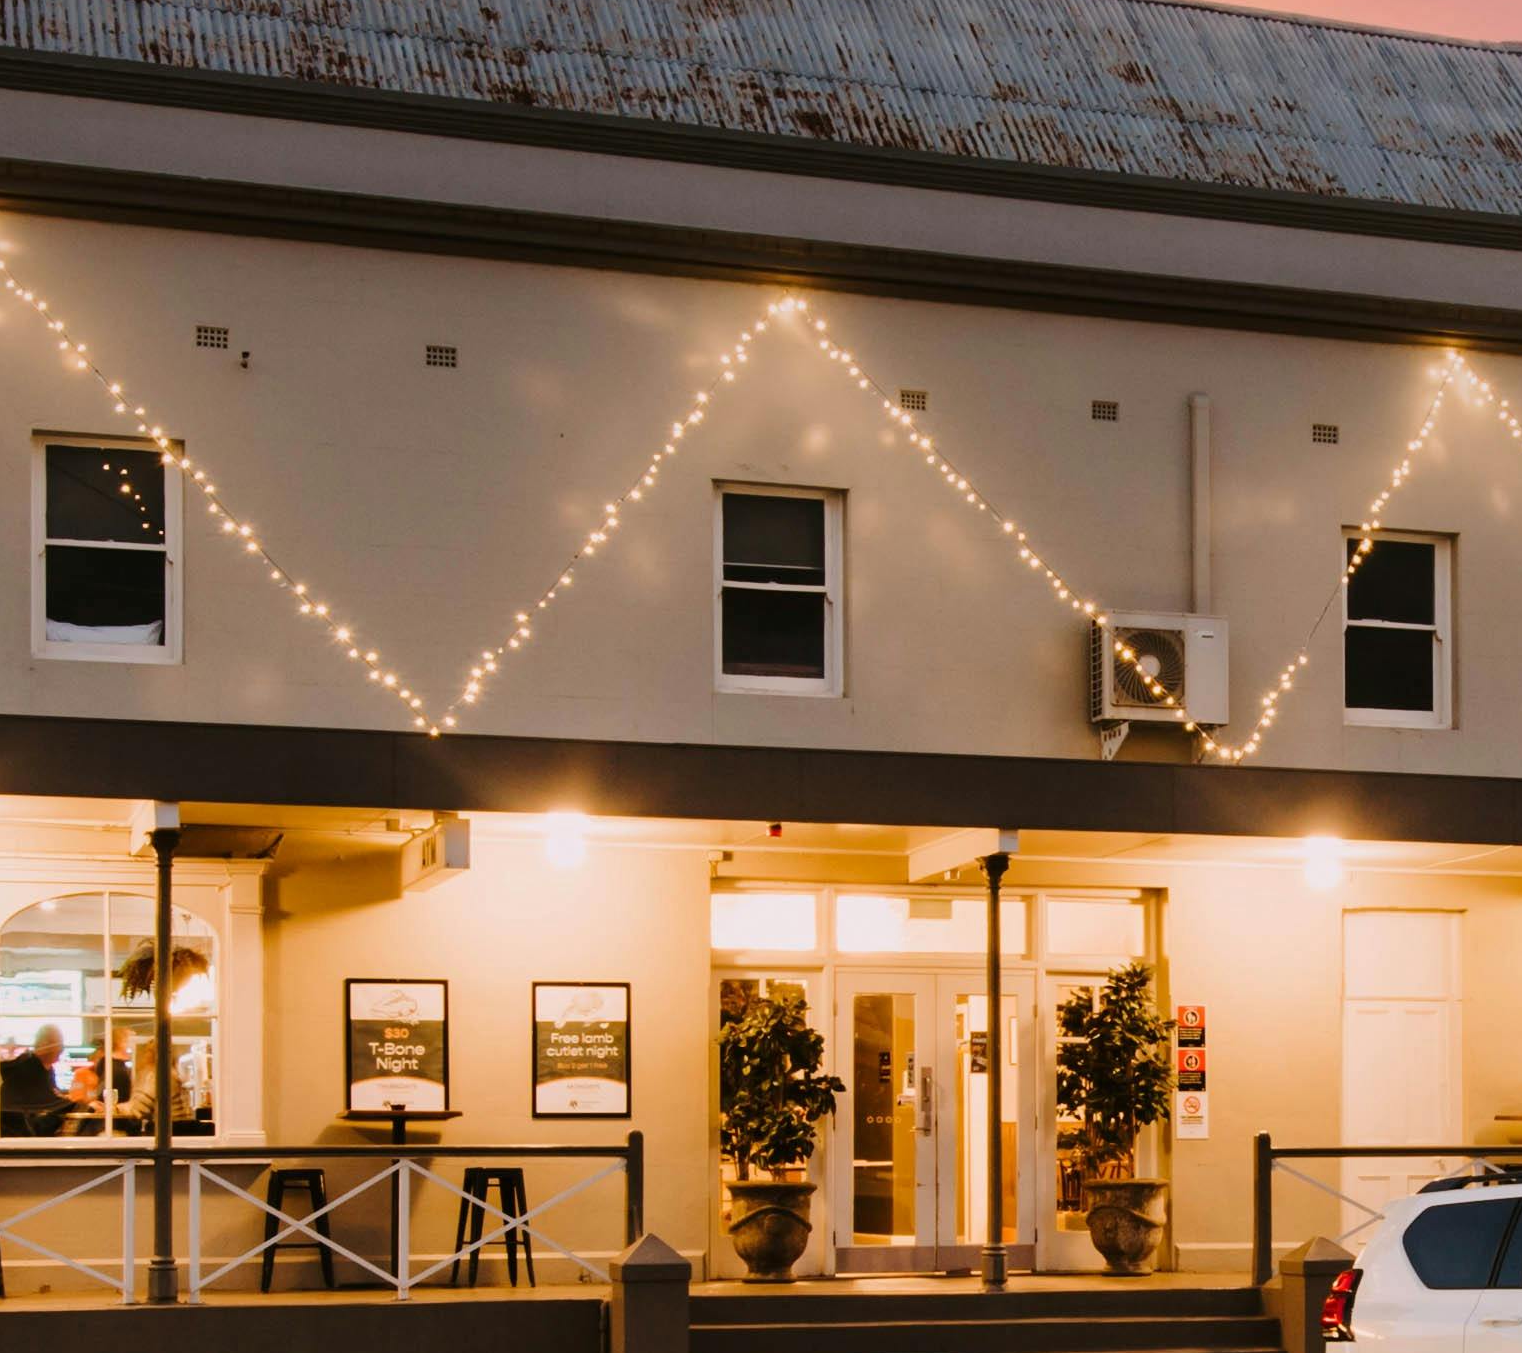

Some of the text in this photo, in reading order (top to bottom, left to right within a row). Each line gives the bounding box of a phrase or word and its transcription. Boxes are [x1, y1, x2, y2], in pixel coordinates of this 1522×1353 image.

[384, 1027, 410, 1039] $30
[550, 1032, 614, 1044] Free lamb
[368, 1042, 426, 1055] T-Bone
[546, 1045, 619, 1059] cutlet night
[376, 1057, 419, 1073] Night
